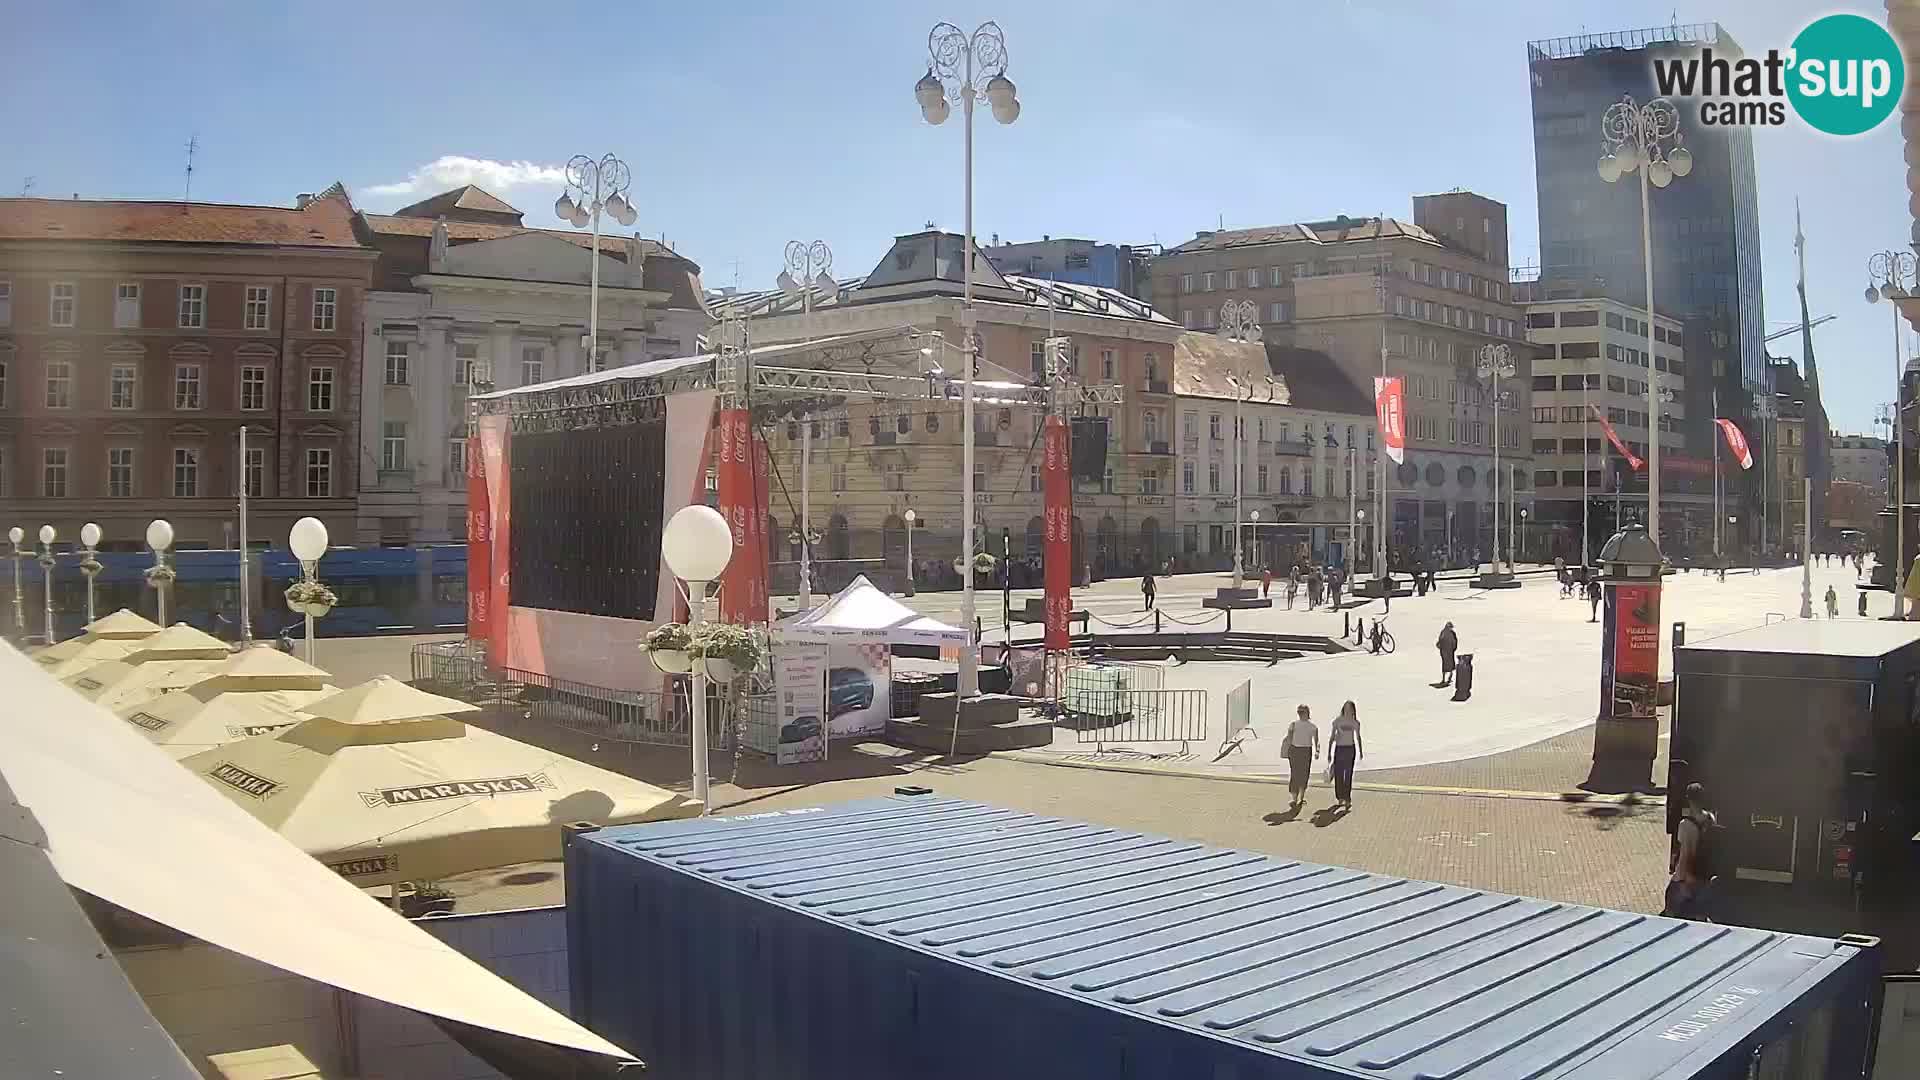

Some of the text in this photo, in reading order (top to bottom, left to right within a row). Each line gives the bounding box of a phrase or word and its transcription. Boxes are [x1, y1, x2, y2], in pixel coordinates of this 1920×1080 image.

[219, 765, 273, 796] MARASKA
[391, 777, 531, 803] MARASKA
[330, 859, 385, 875] RASKA
